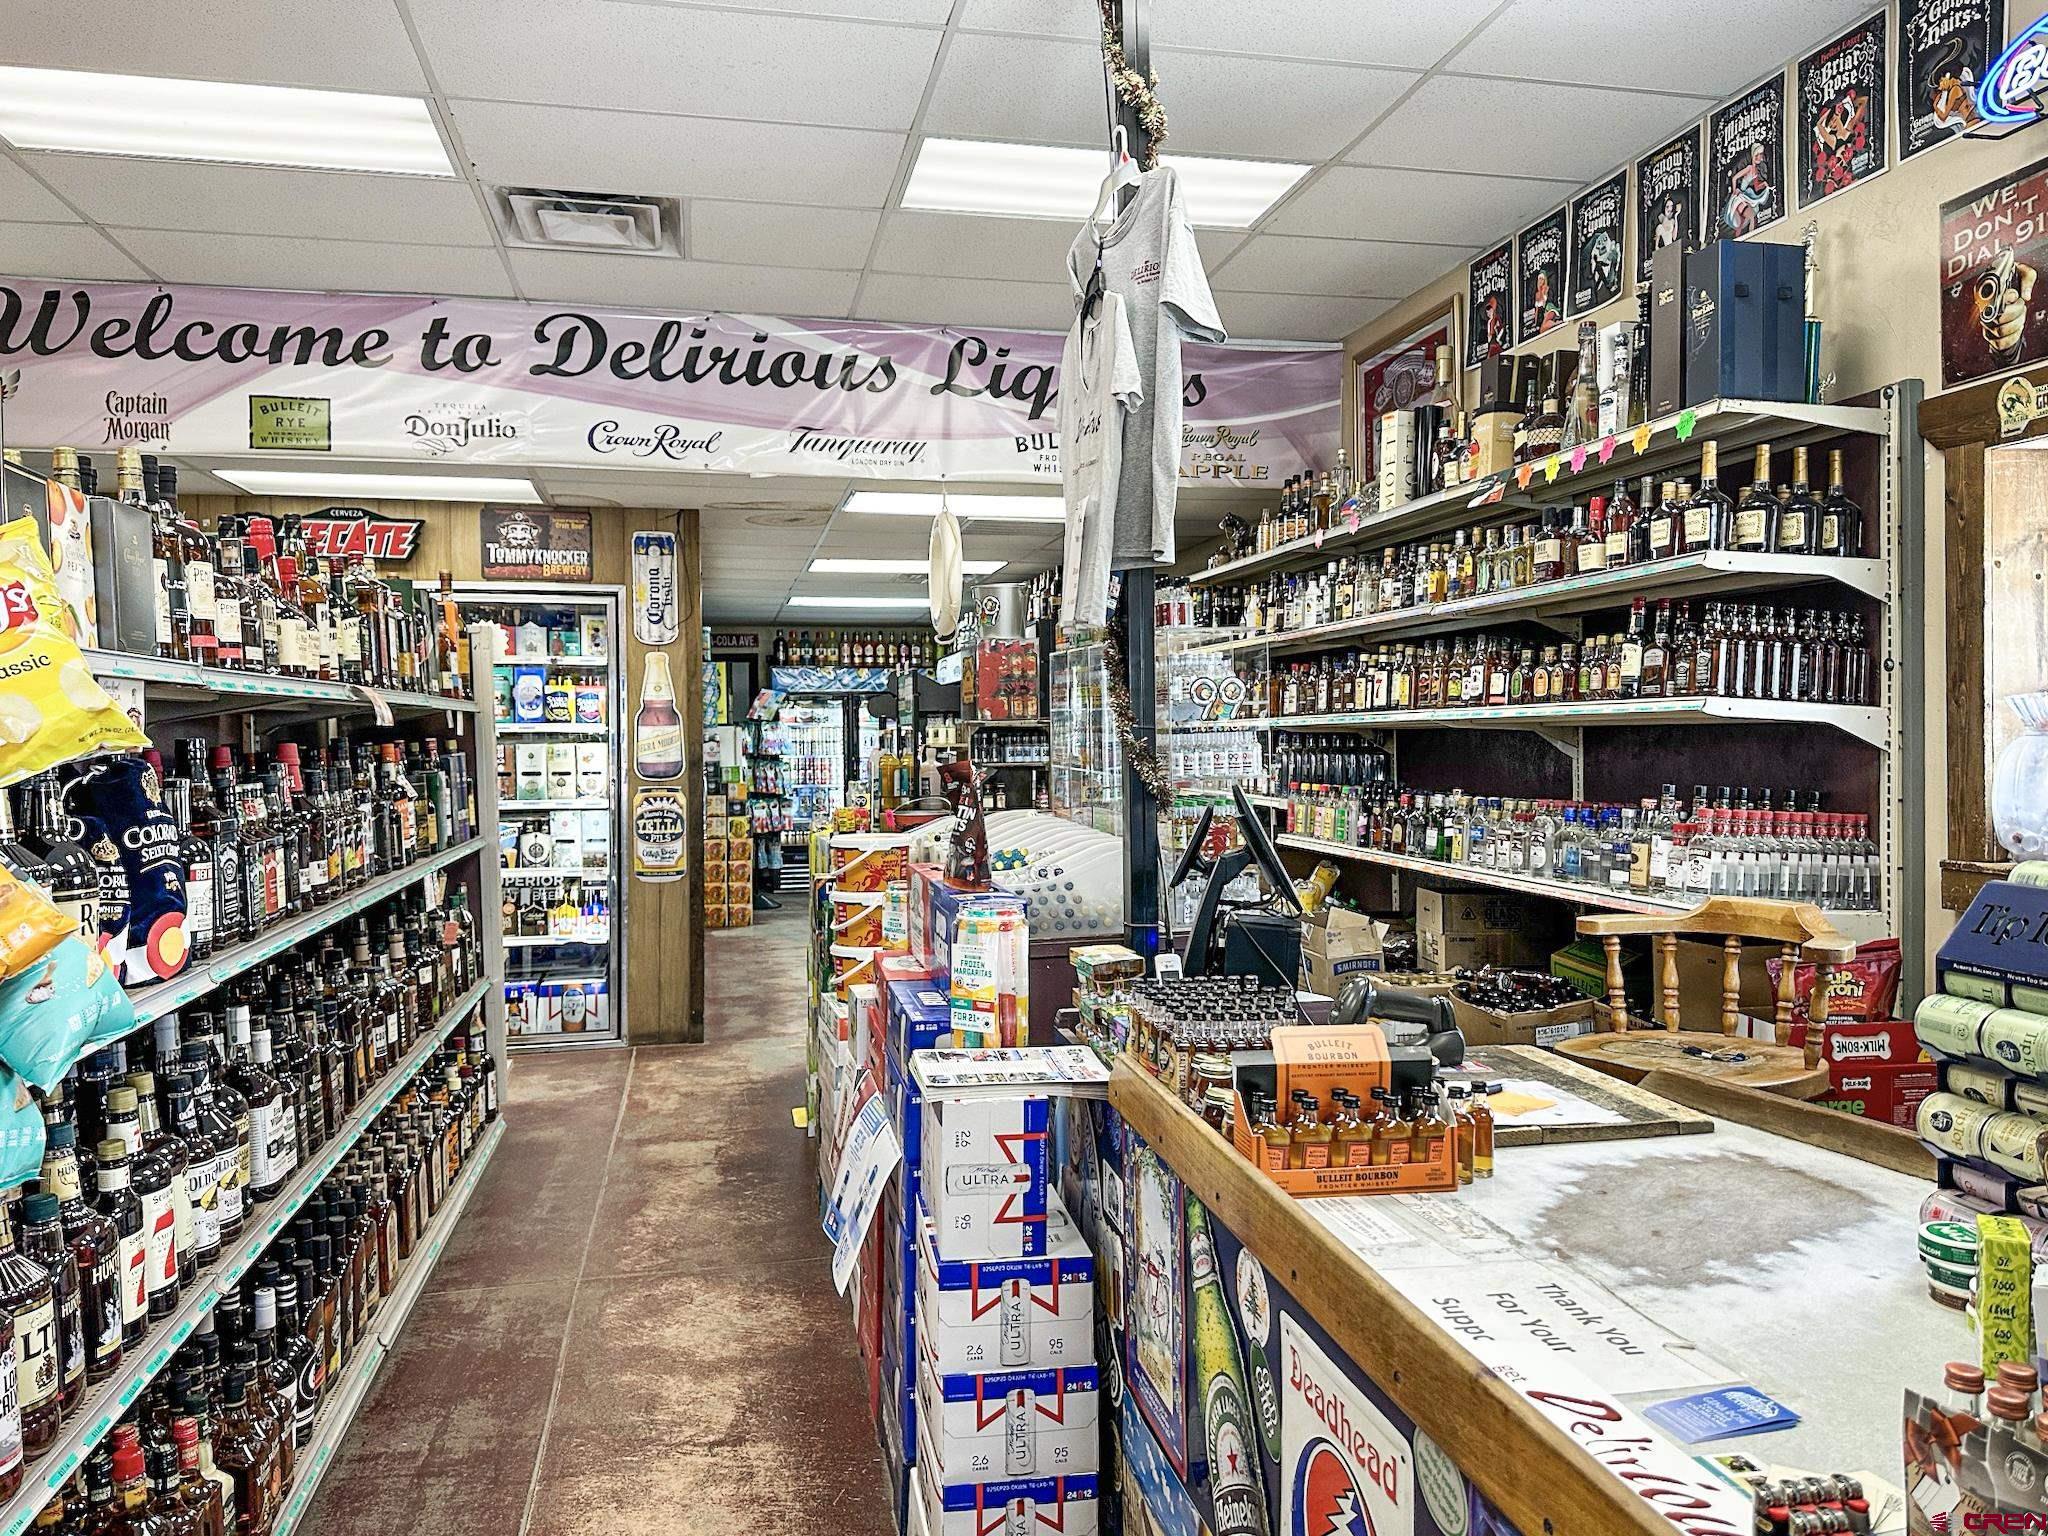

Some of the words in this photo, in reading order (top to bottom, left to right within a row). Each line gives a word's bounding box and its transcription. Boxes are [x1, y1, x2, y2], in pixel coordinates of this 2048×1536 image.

[1820, 48, 1861, 86] Briar
[1823, 69, 1859, 104] Rose
[1724, 101, 1772, 147] Midnight
[1653, 151, 1683, 179] Snow
[1654, 171, 1682, 200] Drop
[1971, 182, 2019, 219] WE
[1584, 197, 1616, 226] Fearless
[1954, 193, 2039, 253] DON'T
[1947, 240, 2009, 279] DIAL
[2015, 211, 2048, 245] 91
[0, 285, 394, 370] Welcome
[420, 316, 502, 372] to
[529, 312, 897, 393] Delirious
[105, 390, 168, 418] Captain
[259, 400, 323, 416] BULLEIT
[433, 401, 487, 411] TEQUILA
[102, 417, 172, 443] Morgan
[275, 416, 306, 429] RYE
[259, 435, 321, 446] WHISKEY
[587, 420, 653, 454] Crown
[633, 424, 722, 461] Royal
[787, 425, 927, 463] Tanqueray
[1215, 425, 1260, 450] Royal
[1178, 463, 1270, 480] APPLE
[329, 509, 363, 518] CERVEZA
[303, 519, 420, 559] ECATE
[486, 542, 588, 566] TOMMYKNOCKER
[542, 564, 588, 577] BREWERY
[646, 566, 665, 626] Corona
[0, 654, 51, 680] assic
[1189, 675, 1247, 722] 99
[636, 818, 684, 835] YELLA
[649, 832, 672, 843] PILS
[1970, 902, 2030, 946] Tip
[960, 958, 985, 969] FROZEN
[1336, 960, 1377, 973] SMIRNOFF
[953, 967, 993, 979] MARGARITAS
[2006, 972, 2025, 982] NEVER
[953, 1012, 967, 1021] FOR
[914, 1023, 926, 1032] 18
[1307, 1038, 1352, 1052] BULLEIT
[1307, 1051, 1358, 1061] BOURBON
[1336, 1061, 1370, 1069] WHISKEY
[960, 1128, 972, 1148] 2.6
[57, 1164, 81, 1178] HUNT
[1315, 1171, 1353, 1185] BULLEIT
[1354, 1169, 1399, 1183] BOURBON
[961, 1173, 1010, 1188] ULTRA
[1318, 1181, 1353, 1190] FRONTIER
[960, 1213, 971, 1230] 95
[1025, 1225, 1033, 1237] 24
[1025, 1241, 1033, 1253] 12
[92, 1263, 119, 1285] HUNT
[1061, 1272, 1073, 1282] 24
[1078, 1270, 1088, 1281] 12
[1010, 1301, 1023, 1350] ULTRA
[1486, 1291, 1526, 1317] For
[1520, 1319, 1577, 1354] Your
[1535, 1281, 1602, 1328] Thank
[1597, 1326, 1646, 1357] You
[965, 1343, 984, 1356] 2.6
[1048, 1337, 1064, 1350] 95
[1492, 1364, 1528, 1384] get
[1066, 1382, 1079, 1392] 24
[1083, 1380, 1093, 1390] 12
[1289, 1344, 1399, 1506] Deadhead
[1015, 1410, 1027, 1461] ULTRA
[971, 1454, 990, 1467] 2.6
[1053, 1446, 1069, 1458] 95
[1066, 1490, 1077, 1500] 24
[1083, 1488, 1093, 1498] 12
